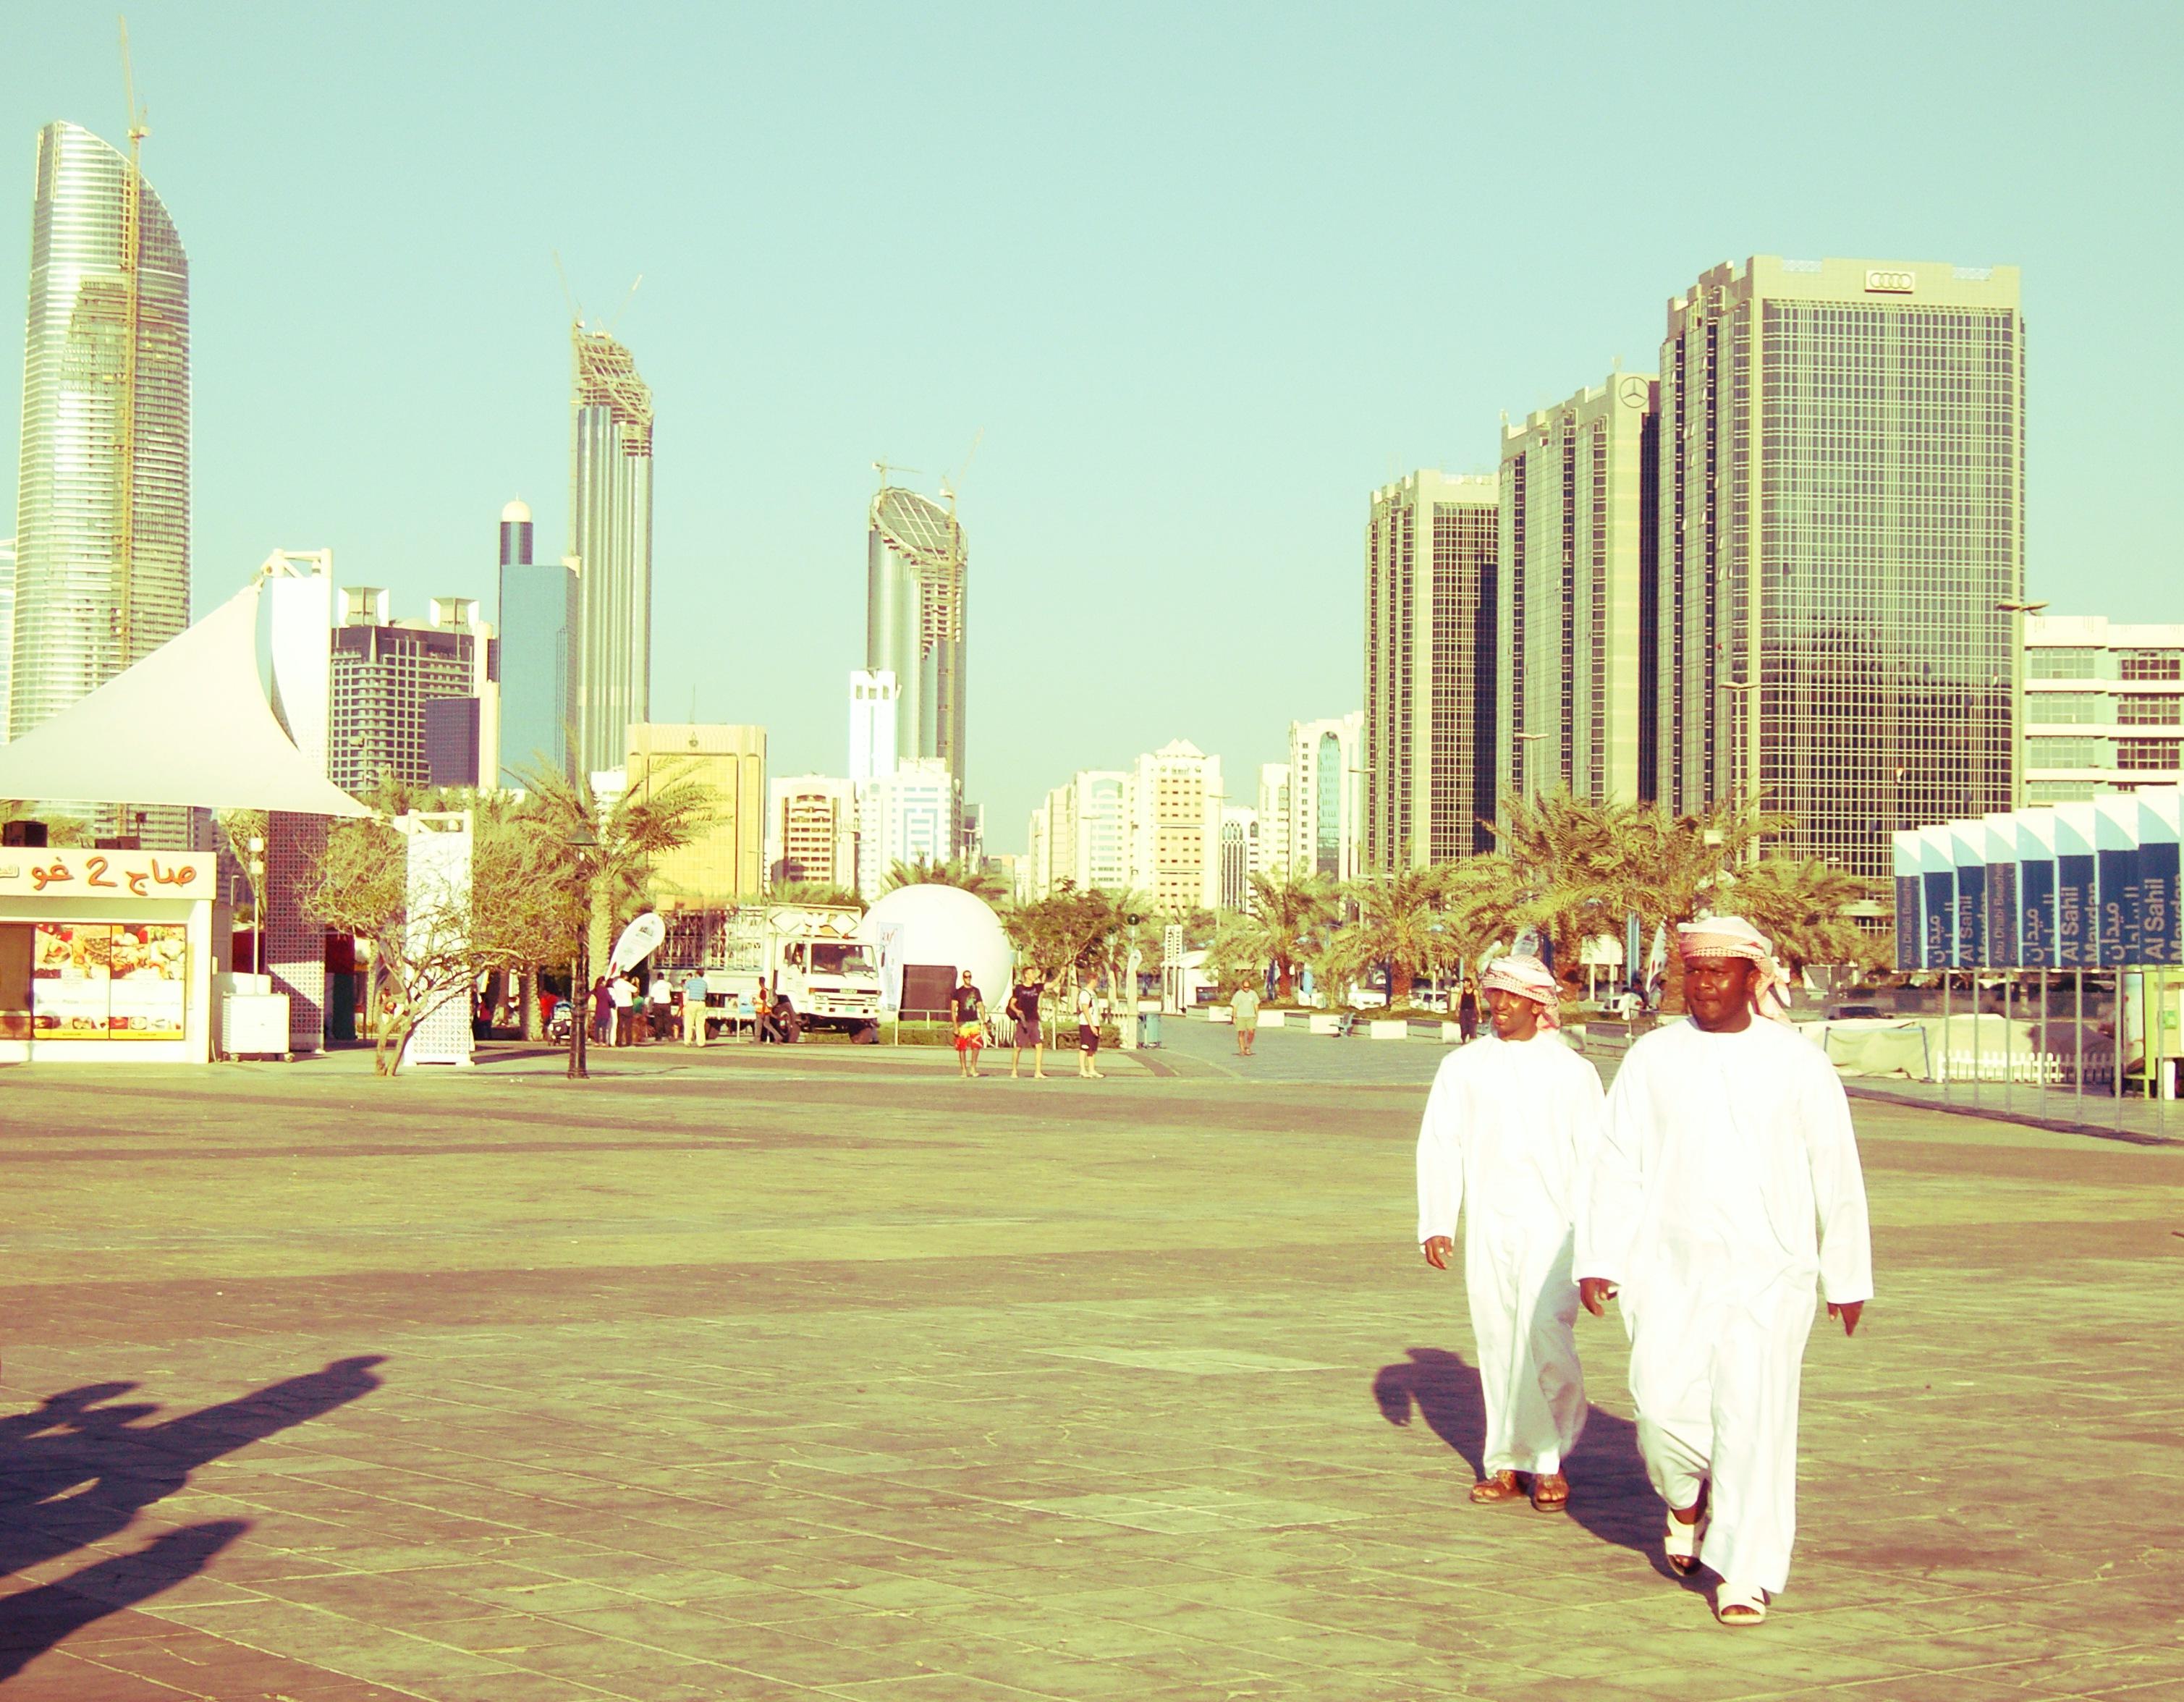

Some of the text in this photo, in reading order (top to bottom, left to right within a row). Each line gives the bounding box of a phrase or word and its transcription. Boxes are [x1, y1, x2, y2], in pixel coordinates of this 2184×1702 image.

[86, 856, 118, 887] 2
[1959, 896, 1973, 962] Al Sahil
[2023, 909, 2044, 962] ميدان
[2061, 886, 2079, 962] Al Sahil
[2100, 902, 2125, 960] ميدان
[2143, 878, 2164, 960] Al Sahil
